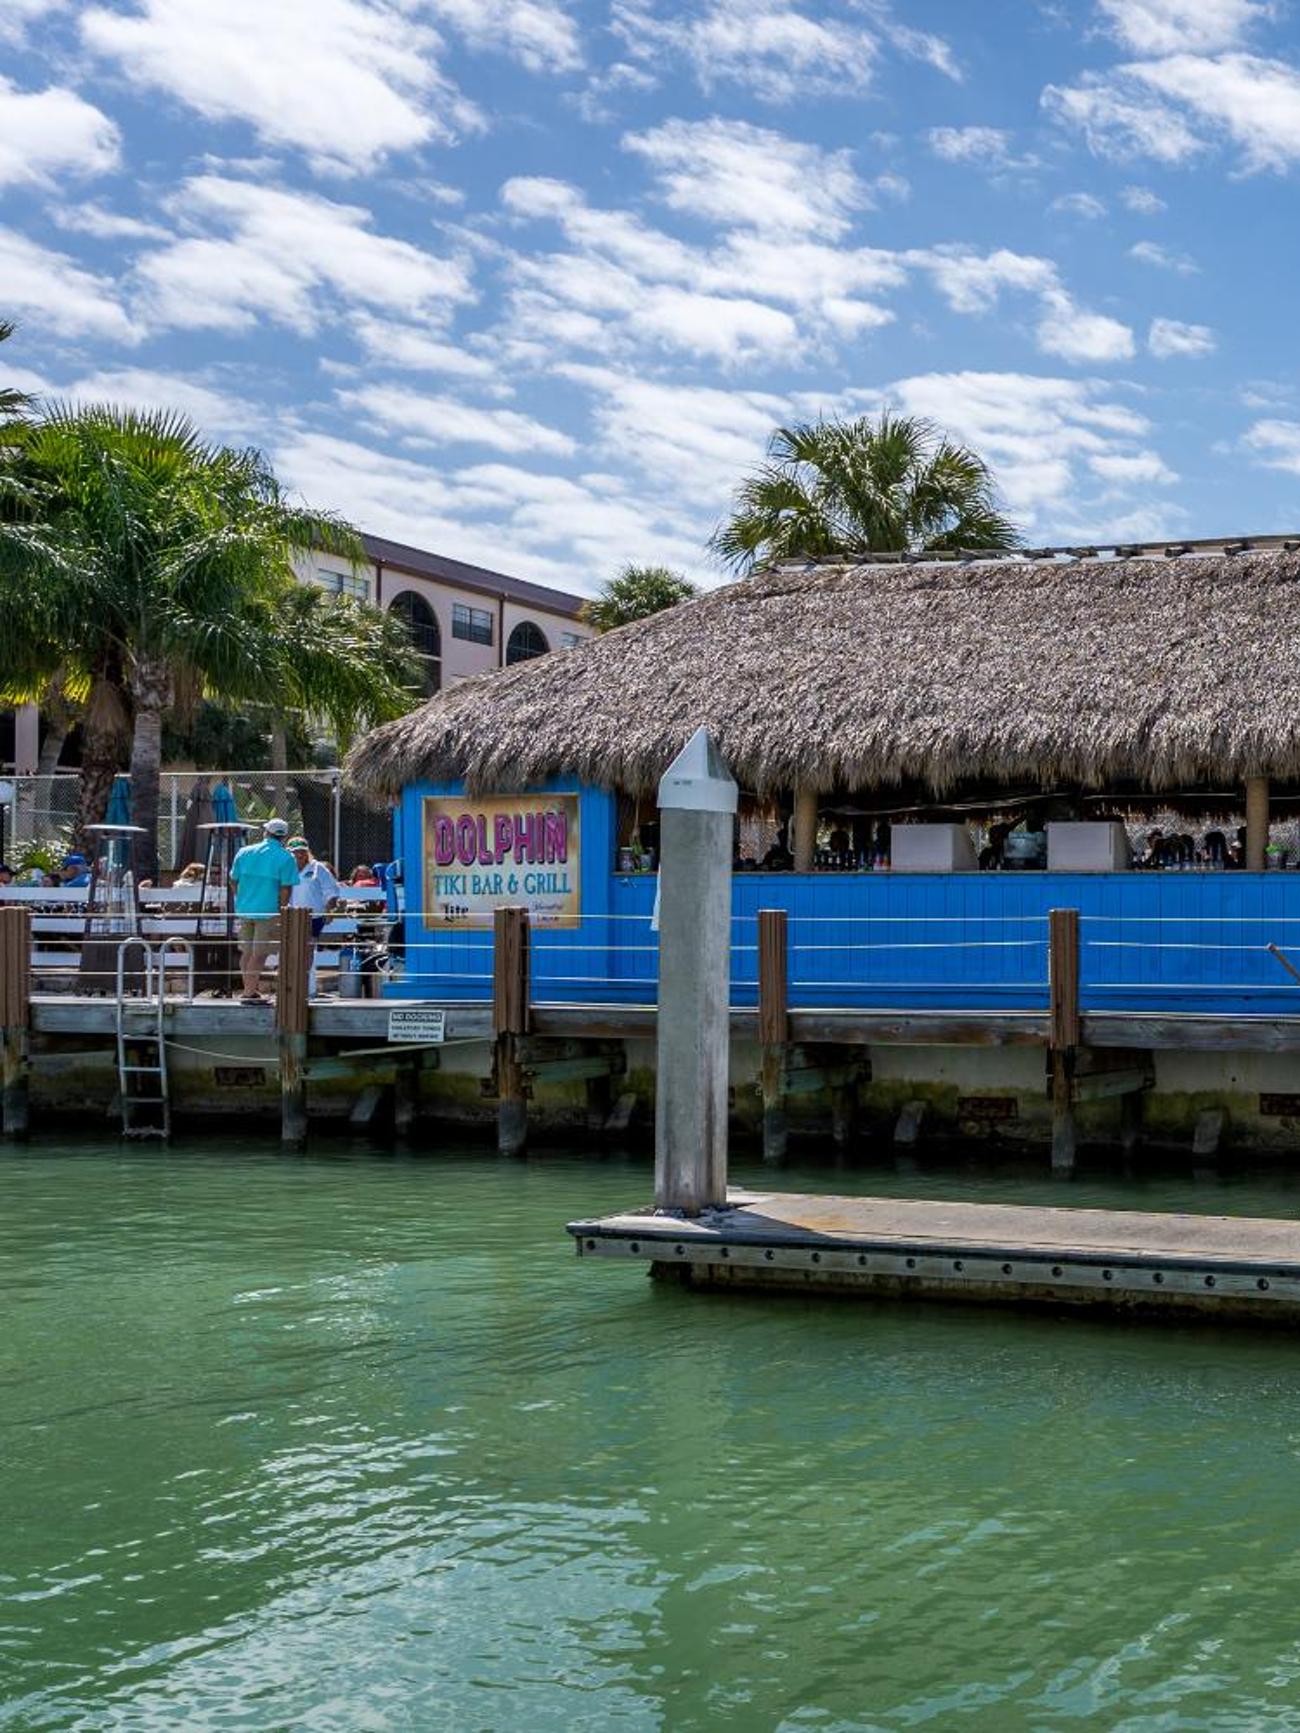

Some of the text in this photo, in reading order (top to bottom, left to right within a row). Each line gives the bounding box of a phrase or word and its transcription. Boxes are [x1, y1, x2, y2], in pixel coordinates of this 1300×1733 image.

[434, 811, 568, 866] DOLPHIN
[433, 872, 571, 896] TIKI BAR & GRILL
